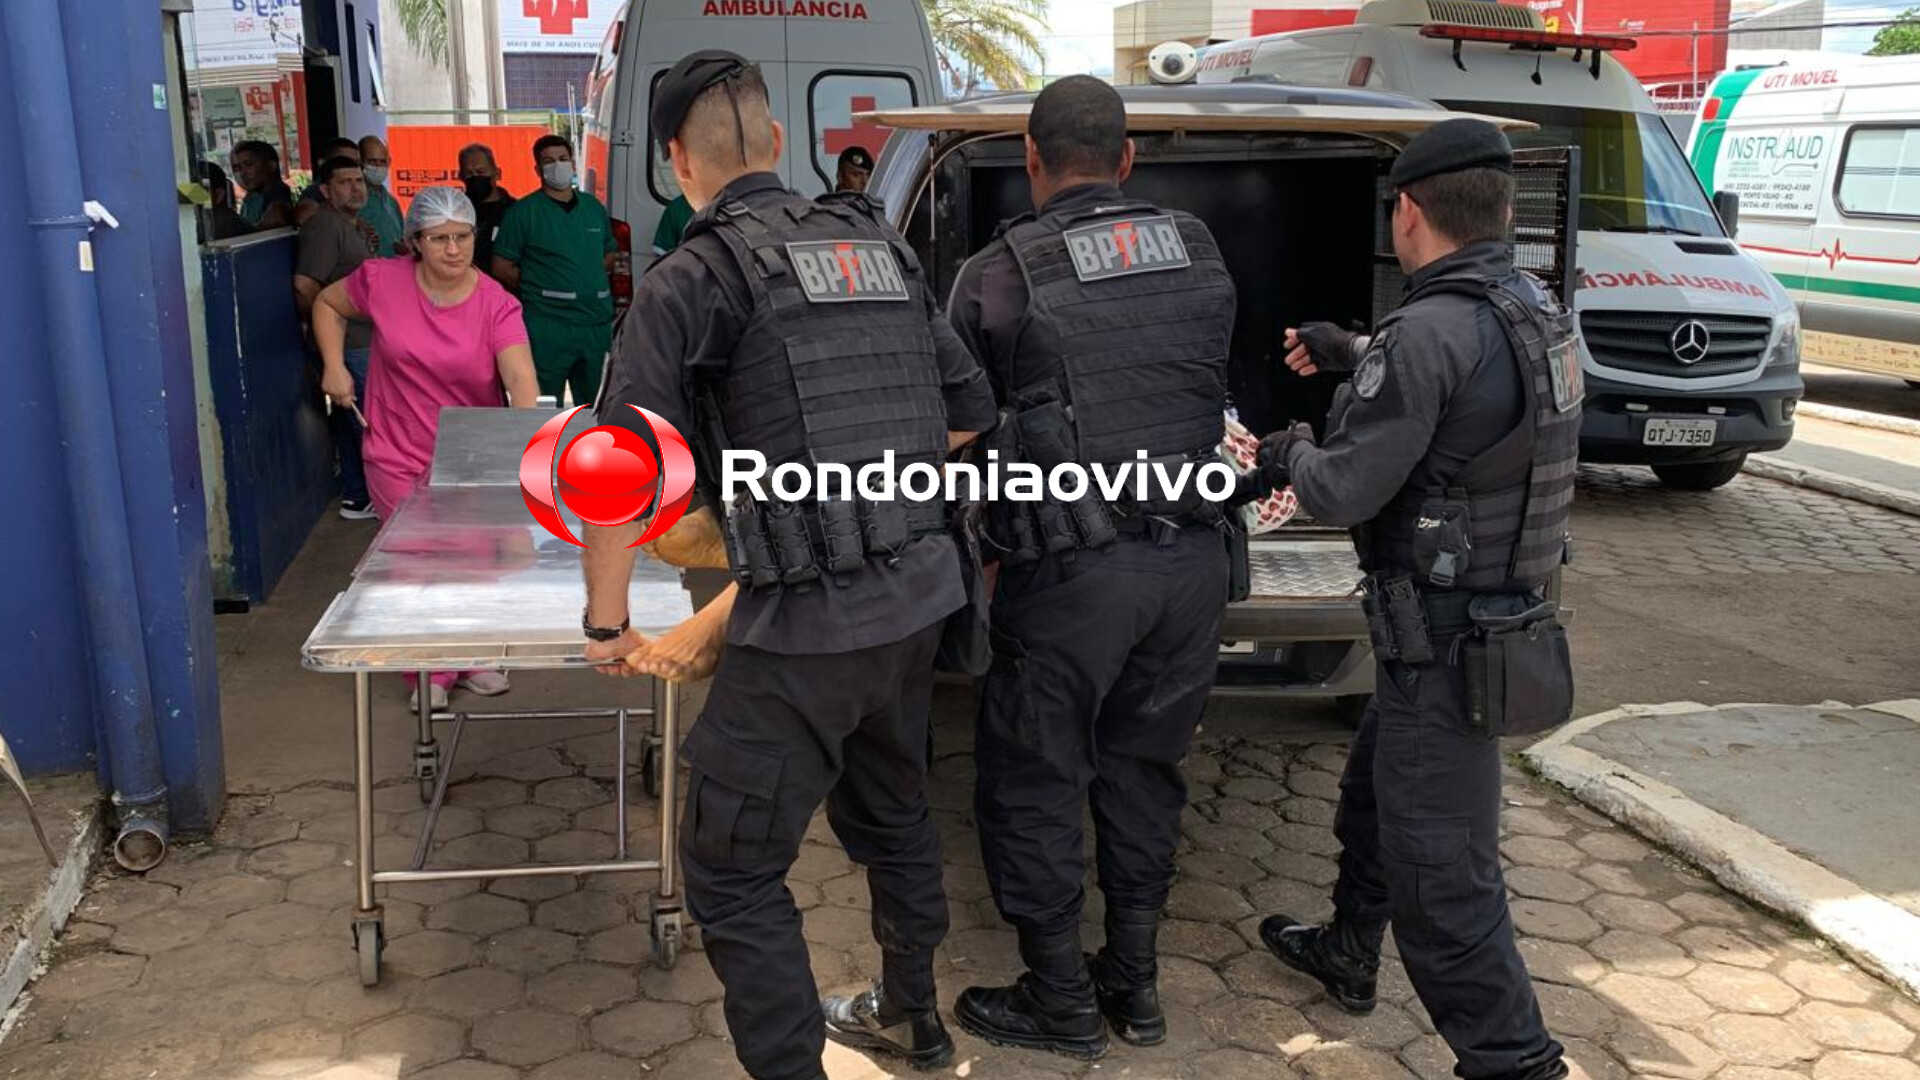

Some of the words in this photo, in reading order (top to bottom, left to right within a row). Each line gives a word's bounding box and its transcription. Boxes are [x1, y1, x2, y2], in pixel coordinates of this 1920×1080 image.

[1764, 74, 1788, 88] UTI
[1790, 70, 1838, 86] MOVEL
[793, 245, 902, 296] BPTAR
[1069, 223, 1184, 274] BPTAR
